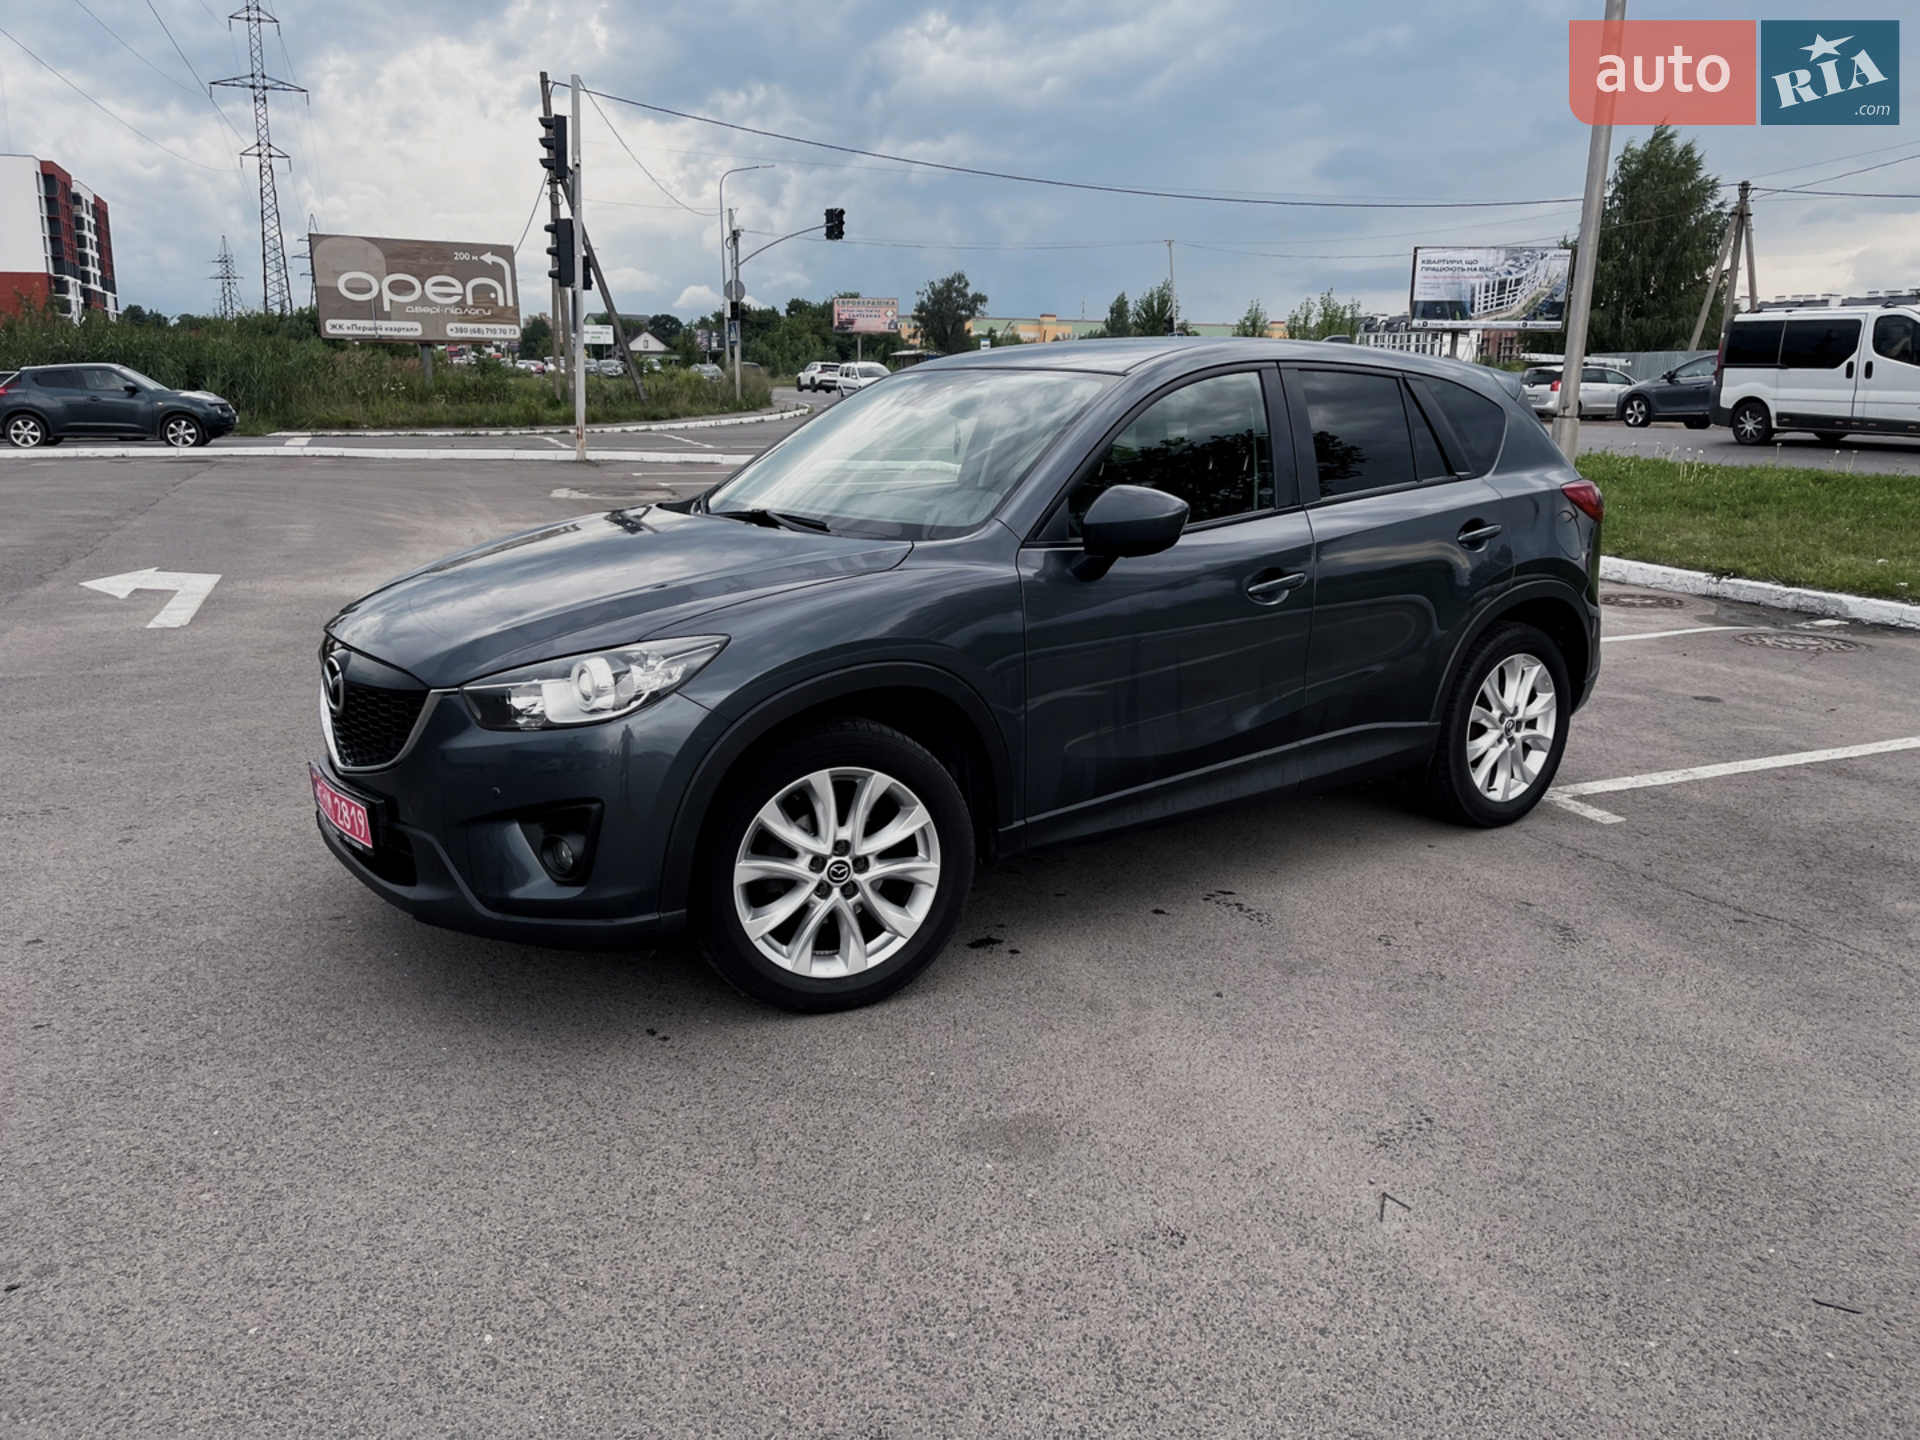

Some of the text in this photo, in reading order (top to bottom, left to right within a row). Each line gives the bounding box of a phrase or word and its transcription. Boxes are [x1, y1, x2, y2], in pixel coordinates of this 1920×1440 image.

[453, 251, 471, 261] 200
[329, 323, 345, 331] ЖК
[449, 326, 469, 334] +380
[469, 327, 485, 336] (68)
[485, 327, 498, 335] 710
[498, 328, 508, 336] 70
